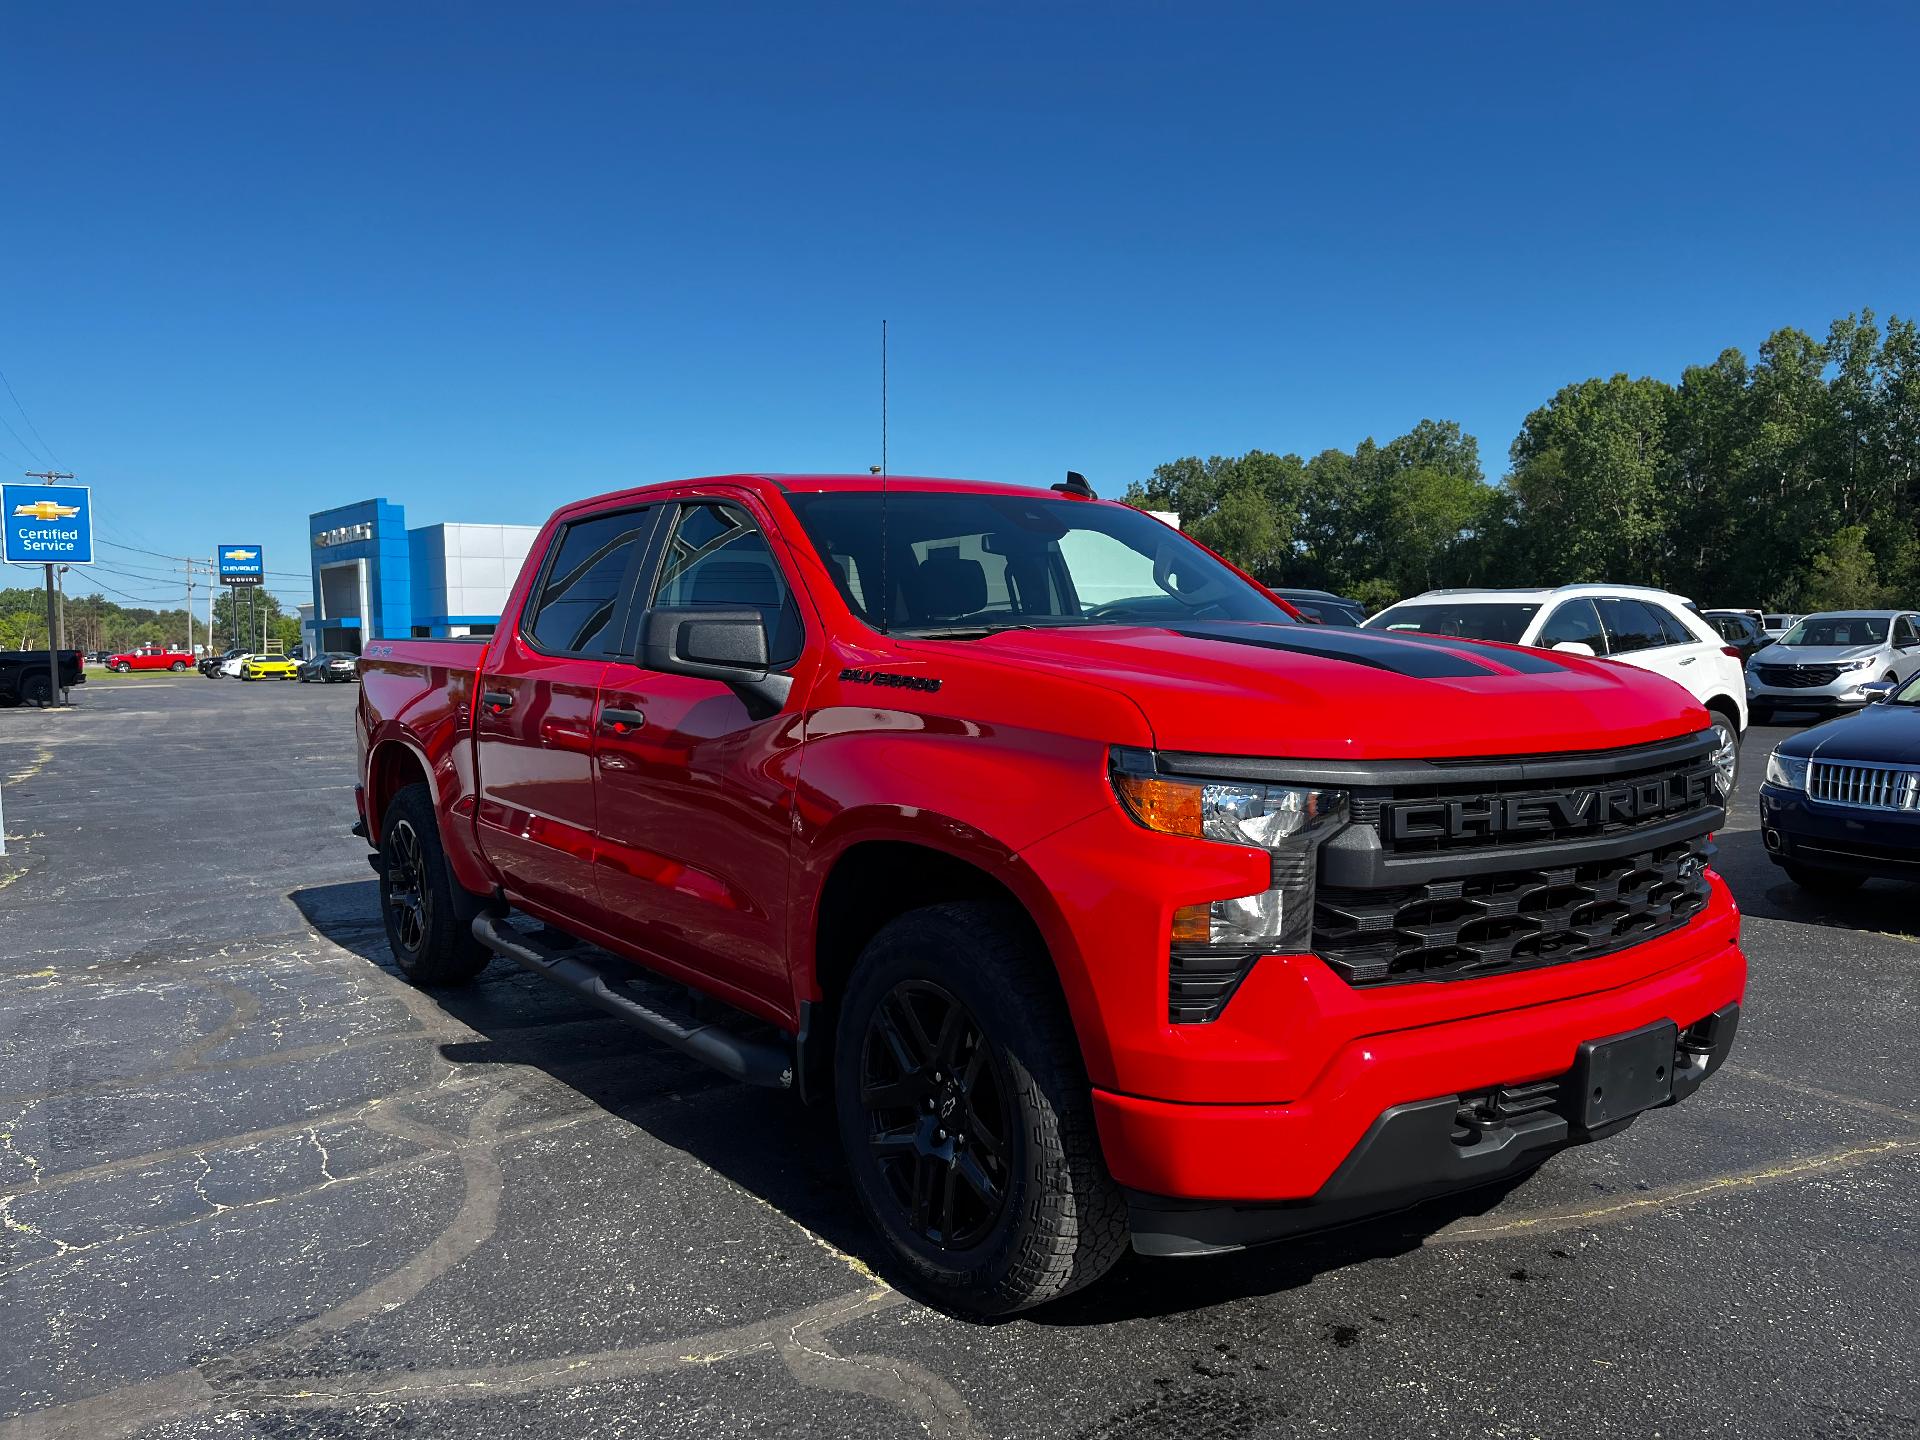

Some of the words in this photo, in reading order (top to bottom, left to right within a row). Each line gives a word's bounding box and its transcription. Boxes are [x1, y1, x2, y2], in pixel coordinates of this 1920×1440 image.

[18, 528, 78, 540] Certified
[23, 540, 75, 551] Service
[1392, 765, 1718, 839] CHEVROLET
